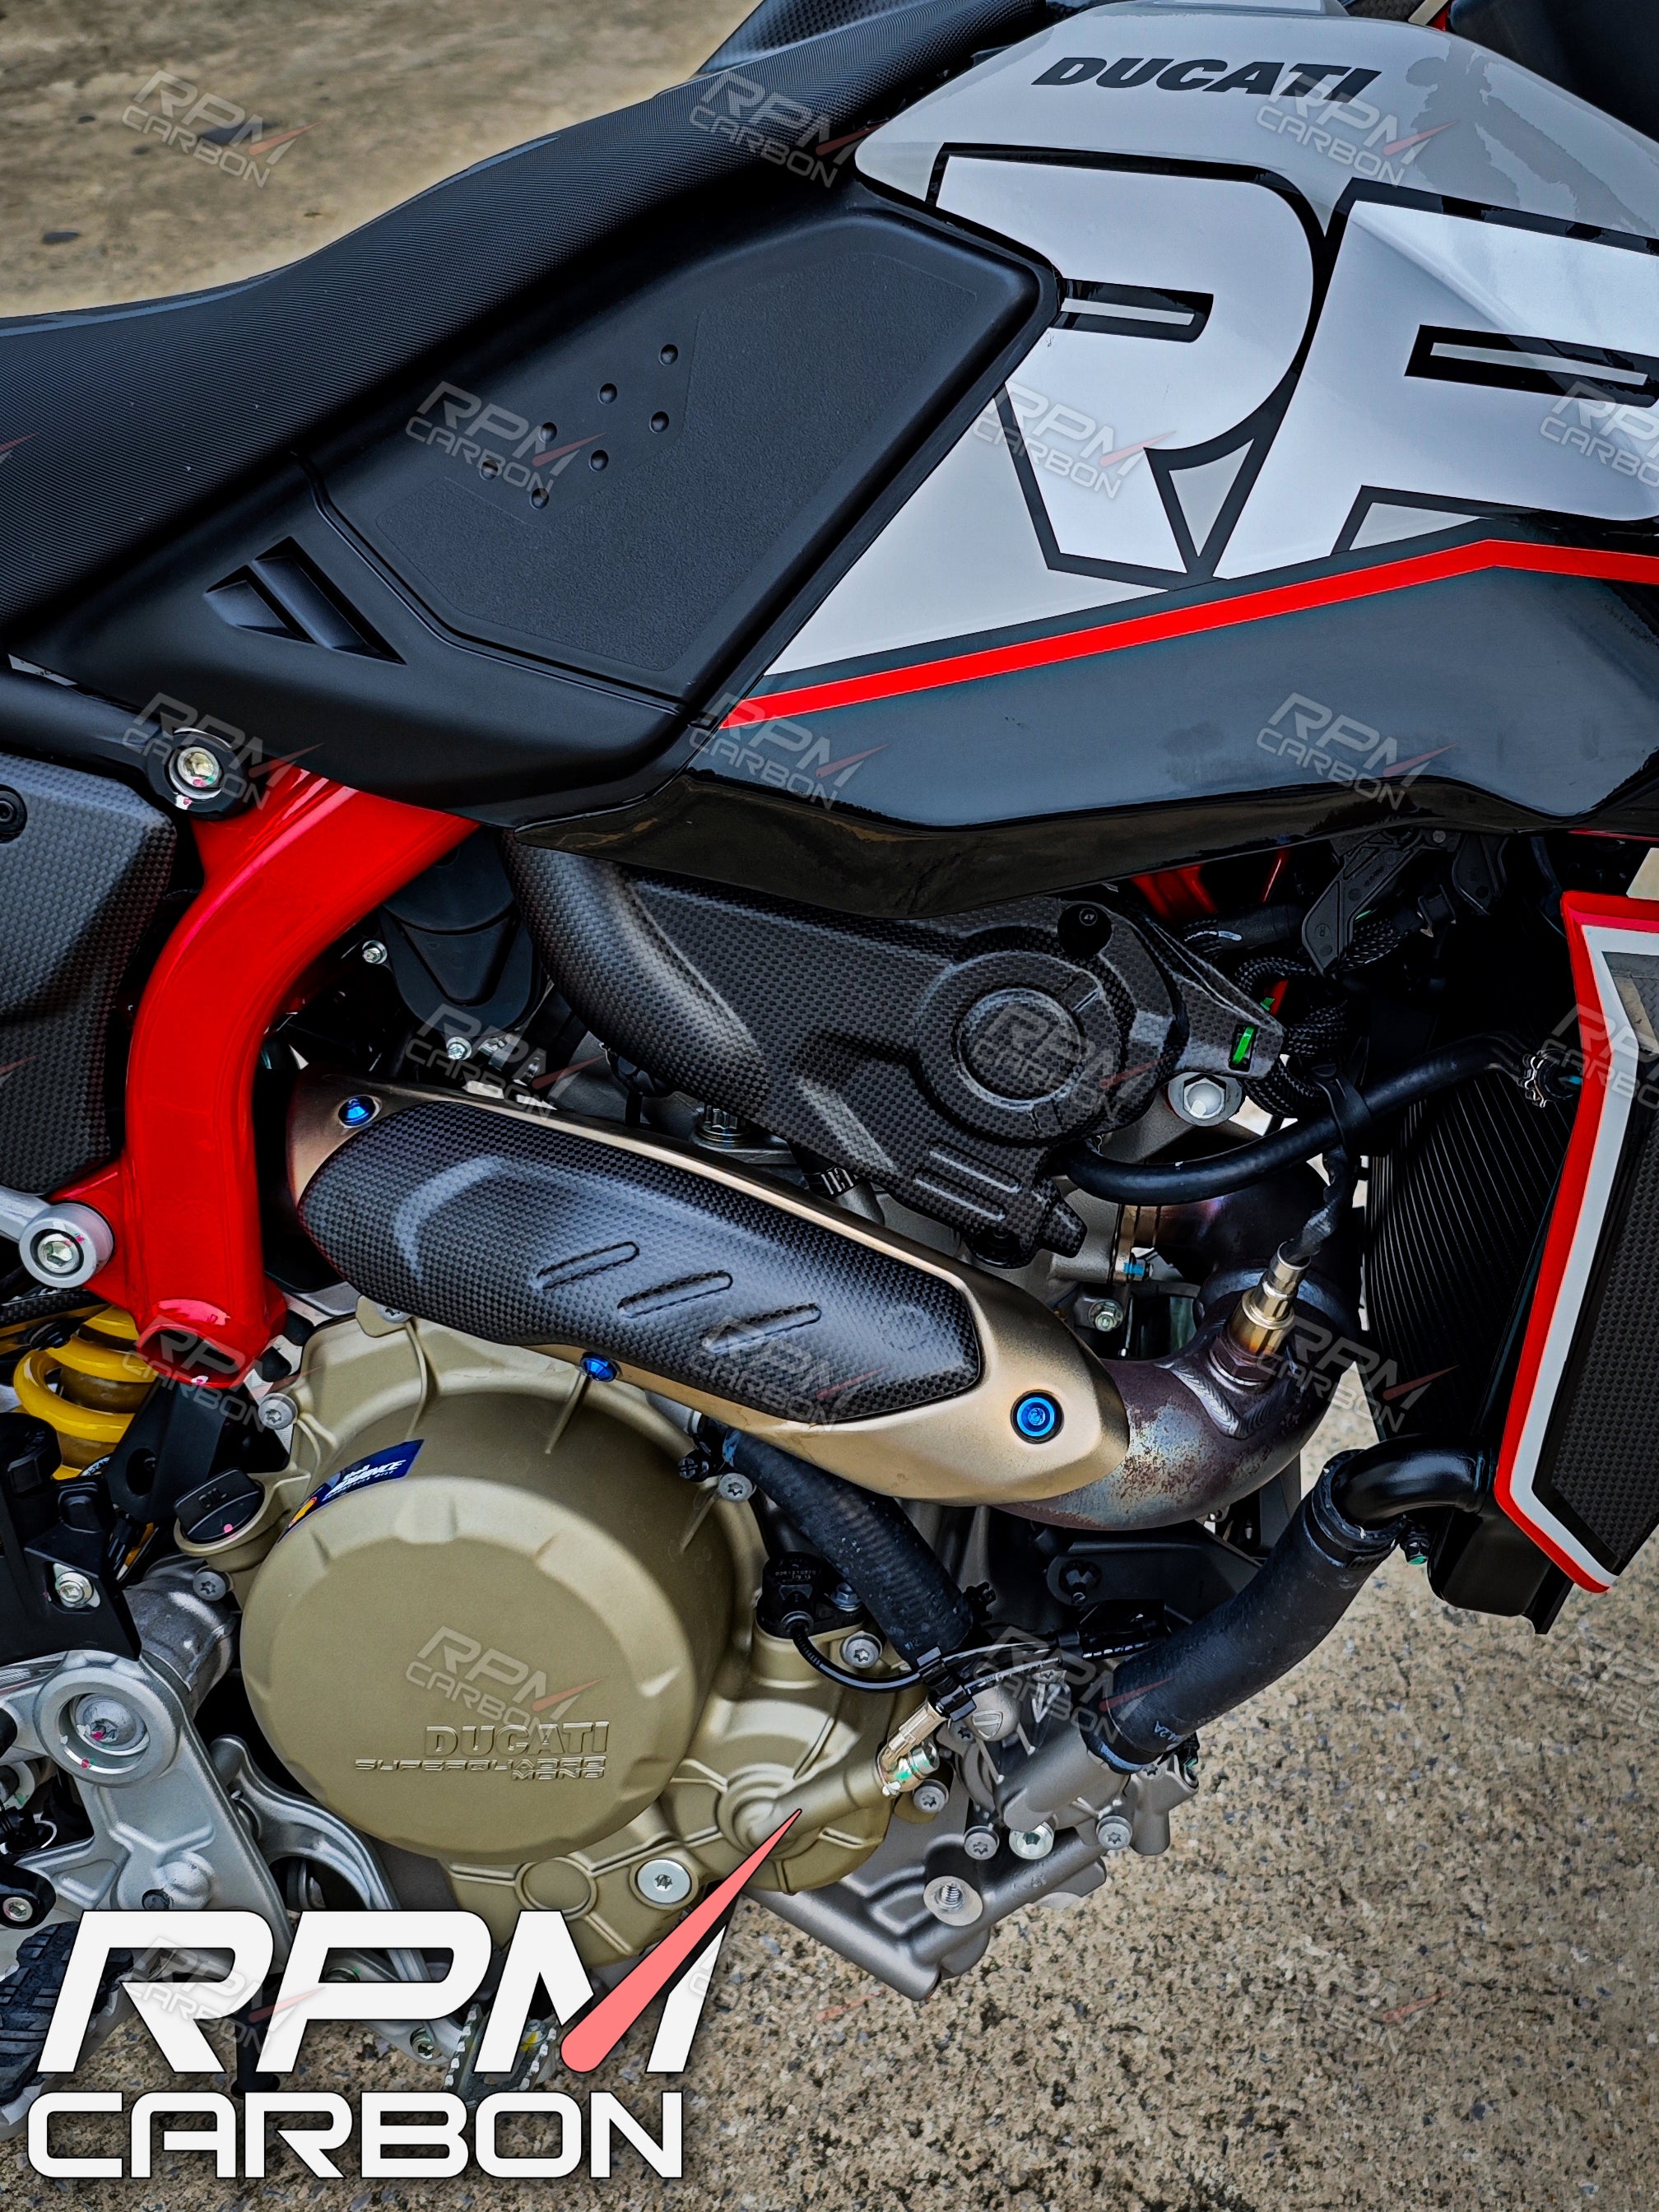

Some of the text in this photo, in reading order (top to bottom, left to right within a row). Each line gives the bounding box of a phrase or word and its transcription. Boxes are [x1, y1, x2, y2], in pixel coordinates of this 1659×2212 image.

[1031, 57, 1382, 104] DUCATI
[199, 1487, 227, 1508] OIL
[425, 1721, 610, 1757] DUCATI
